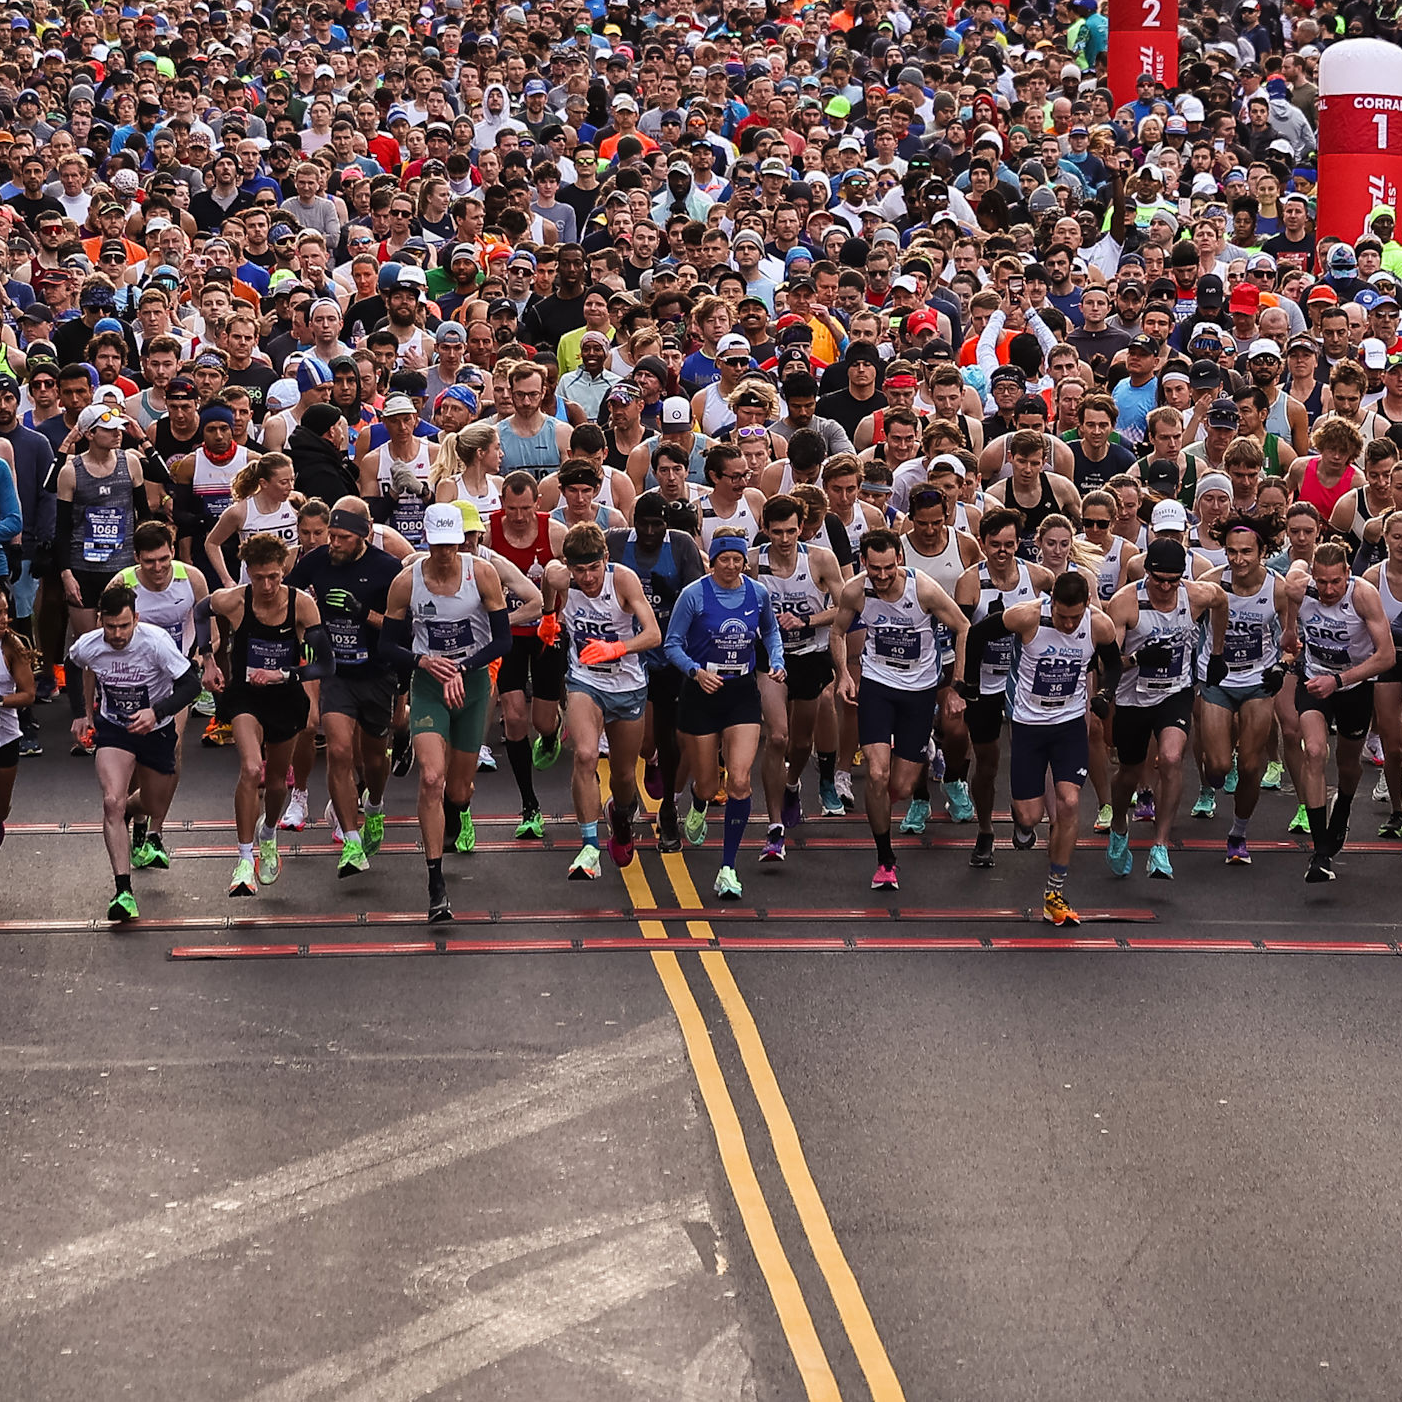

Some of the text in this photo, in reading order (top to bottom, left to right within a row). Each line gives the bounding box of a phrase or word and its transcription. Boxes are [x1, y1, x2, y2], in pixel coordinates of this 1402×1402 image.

[1372, 113, 1388, 149] 1
[91, 524, 119, 535] 1068
[396, 521, 423, 531] 1080
[1305, 625, 1351, 642] GRC
[330, 634, 358, 645] 1032
[727, 650, 737, 659] 18
[891, 646, 905, 654] 40
[1234, 649, 1247, 658] 43
[263, 657, 277, 666] 35
[1049, 684, 1063, 692] 36
